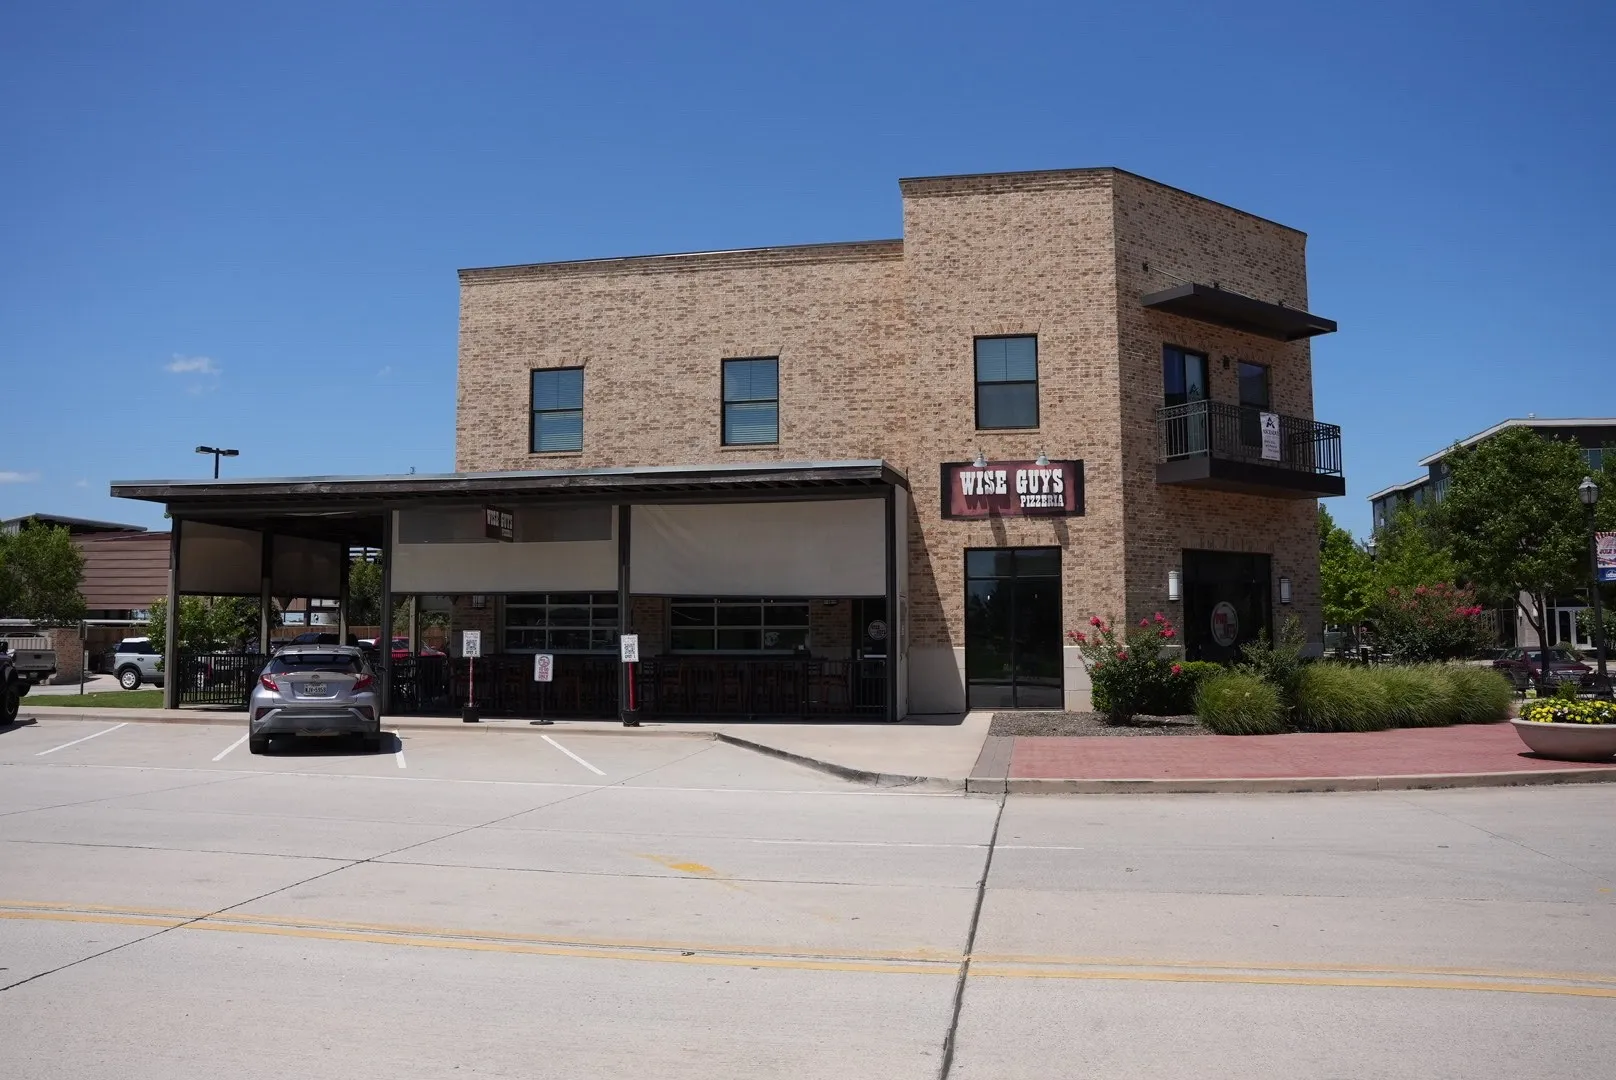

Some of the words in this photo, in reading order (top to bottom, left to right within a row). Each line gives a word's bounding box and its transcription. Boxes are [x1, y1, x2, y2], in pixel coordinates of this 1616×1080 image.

[960, 470, 1007, 495] WISE
[1016, 468, 1064, 494] GUYS
[1020, 494, 1065, 508] PIZZERIA
